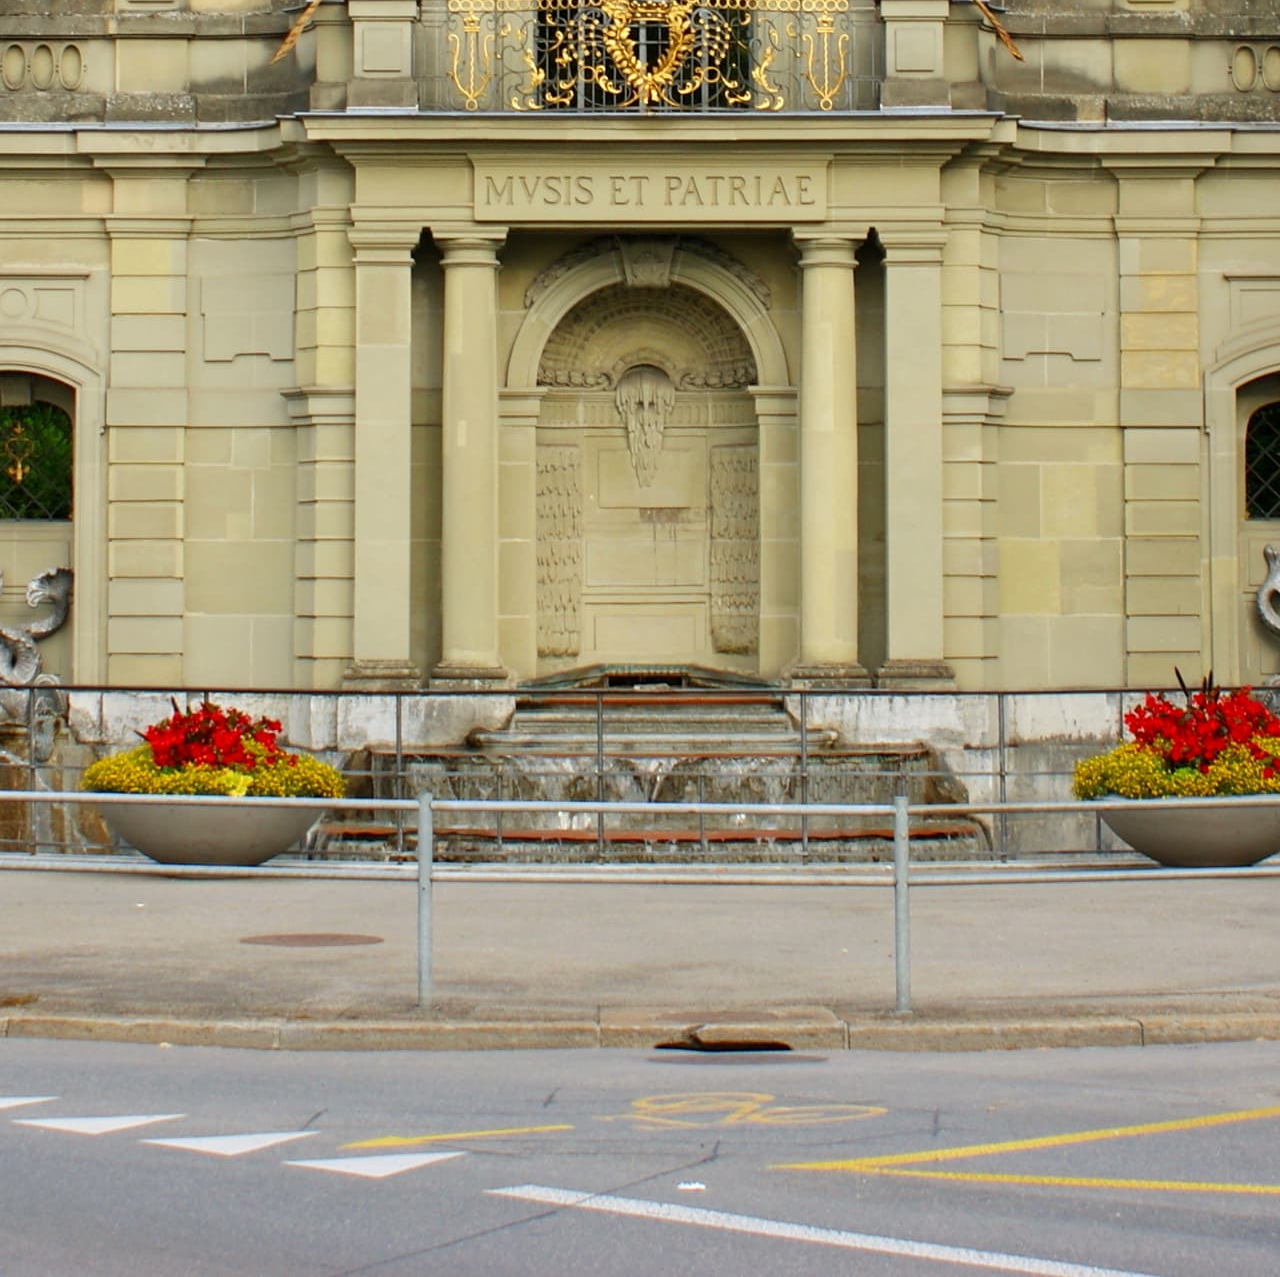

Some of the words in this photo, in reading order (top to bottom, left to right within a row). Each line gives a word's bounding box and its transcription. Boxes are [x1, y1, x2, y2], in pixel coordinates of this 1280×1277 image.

[484, 175, 594, 206] MVSIS
[608, 175, 650, 206] ET
[663, 175, 816, 206] PATRIAE
